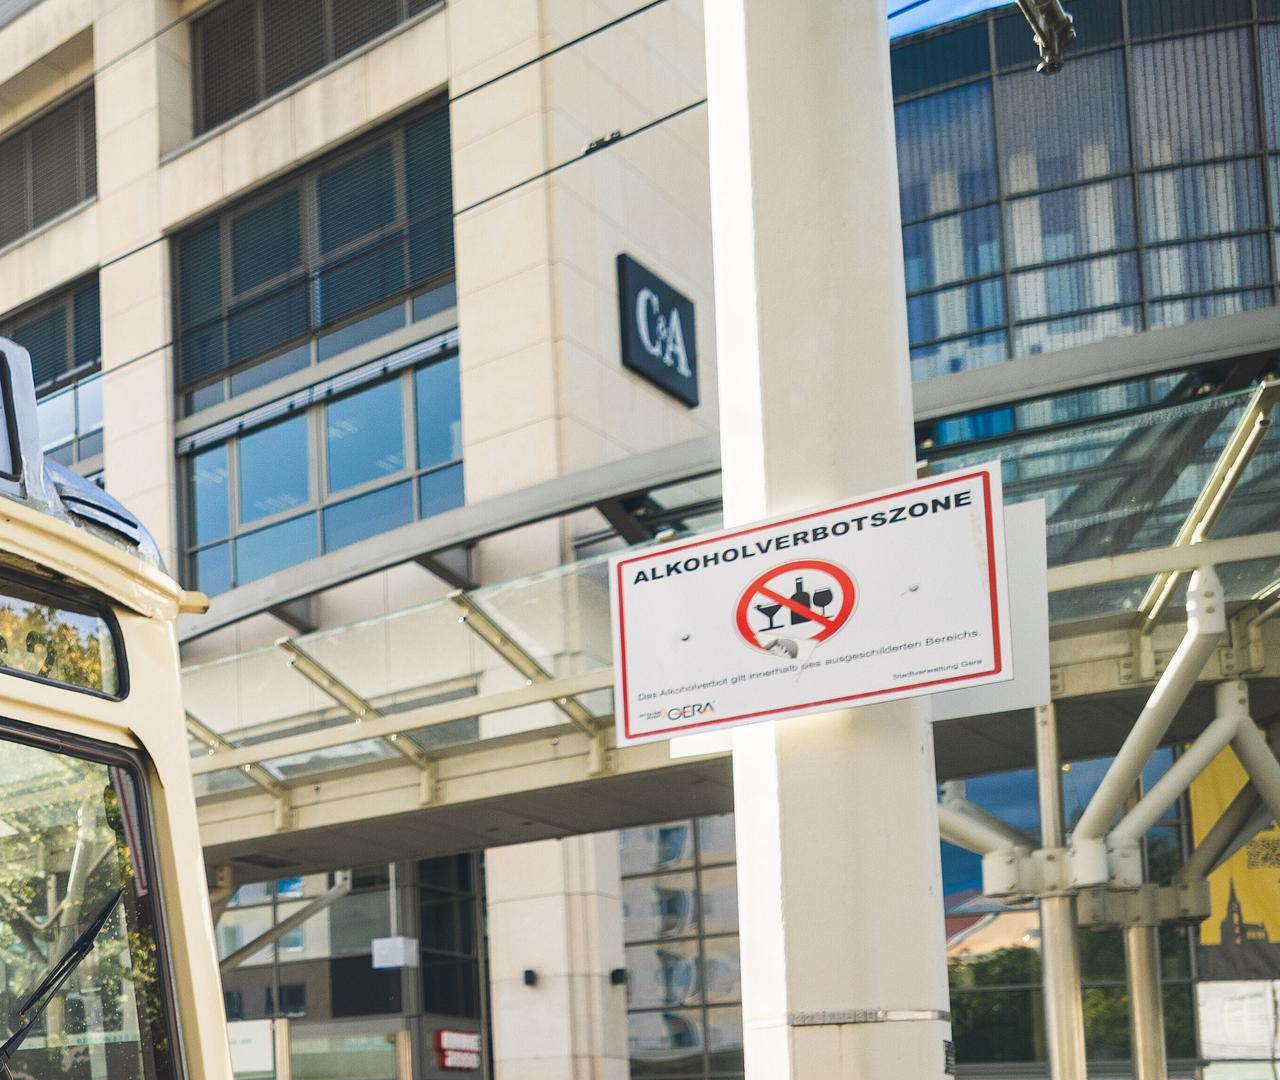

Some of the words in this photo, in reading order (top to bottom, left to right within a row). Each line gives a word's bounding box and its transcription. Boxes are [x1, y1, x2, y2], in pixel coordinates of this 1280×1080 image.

[635, 287, 692, 379] C&A
[633, 490, 972, 585] ALKOHOLVERBOTSZONE
[660, 678, 728, 697] Alkoholverbot
[749, 664, 798, 681] innerhalb
[825, 640, 922, 665] ausgeschilderten
[892, 662, 959, 680] Stadtverwaltung
[961, 658, 982, 668] Gera
[668, 702, 714, 721] GERA
